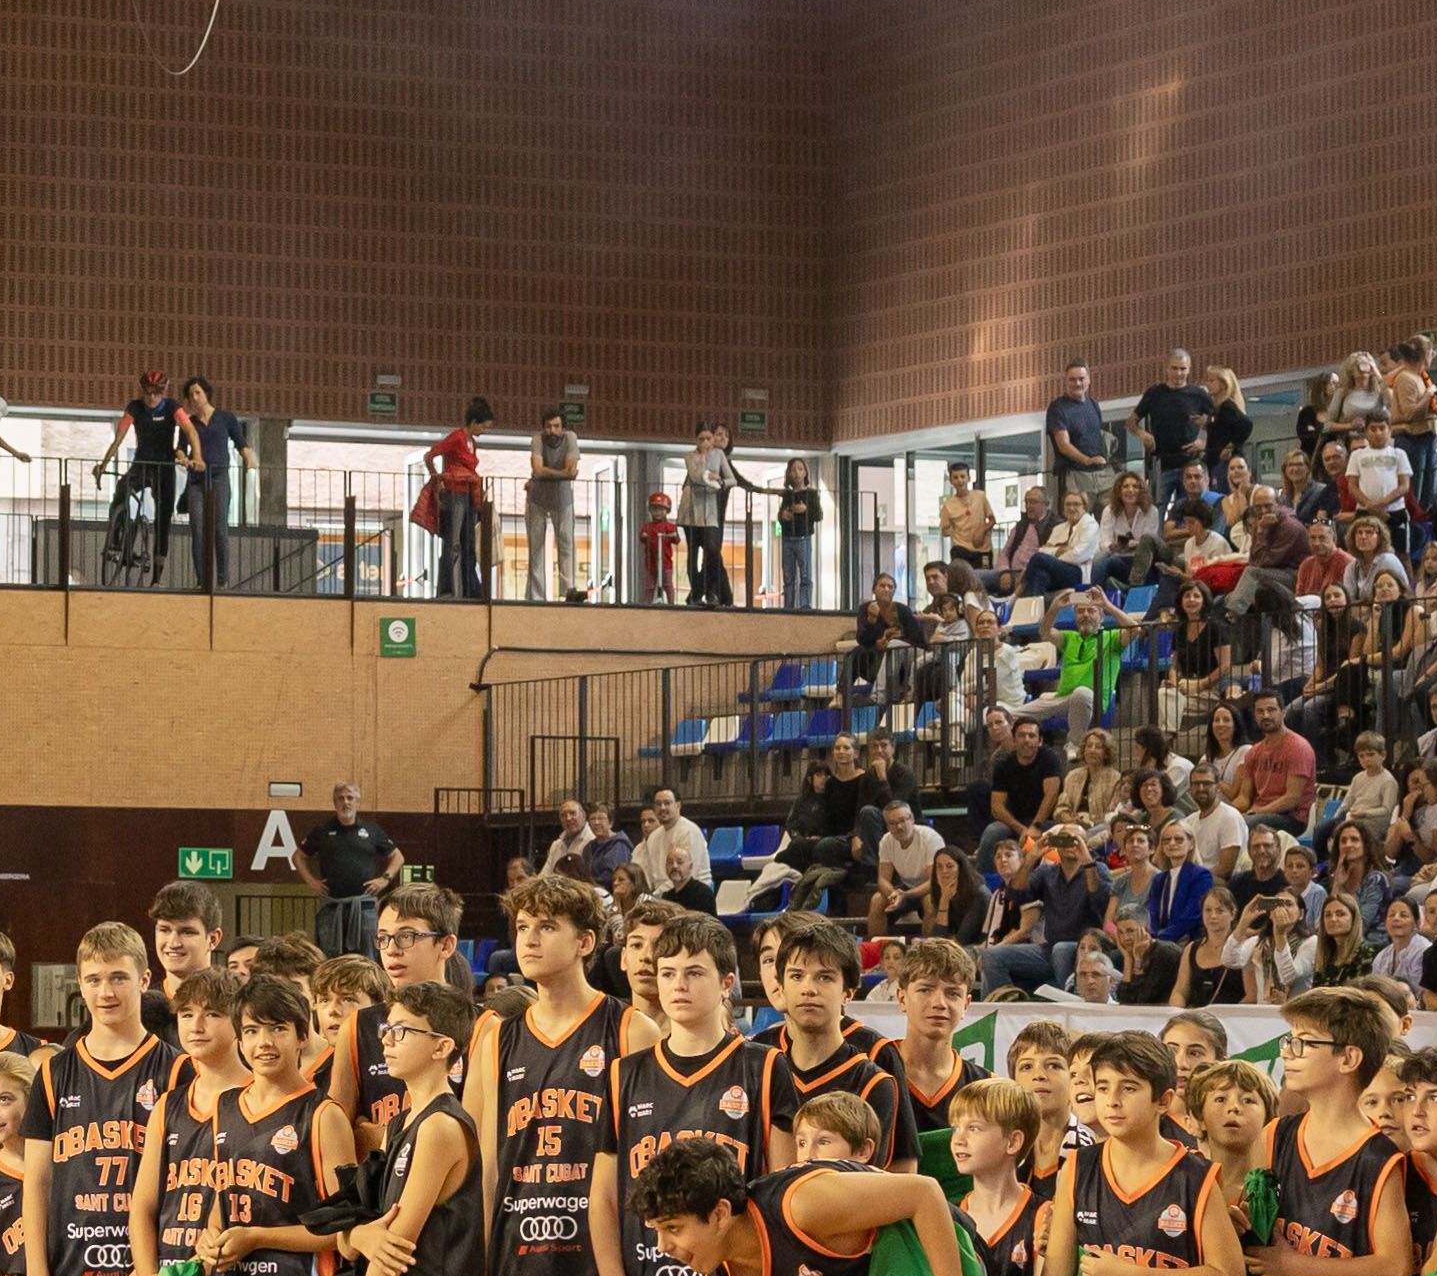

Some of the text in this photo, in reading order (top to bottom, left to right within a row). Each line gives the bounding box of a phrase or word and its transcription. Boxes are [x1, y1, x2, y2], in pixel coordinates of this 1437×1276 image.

[250, 809, 298, 871] A
[536, 1124, 563, 1156] 15
[95, 1156, 128, 1187] 77
[545, 1162, 588, 1183] CUGAT
[74, 1193, 108, 1212] SANT
[178, 1192, 204, 1222] 16
[228, 1193, 252, 1223] 13
